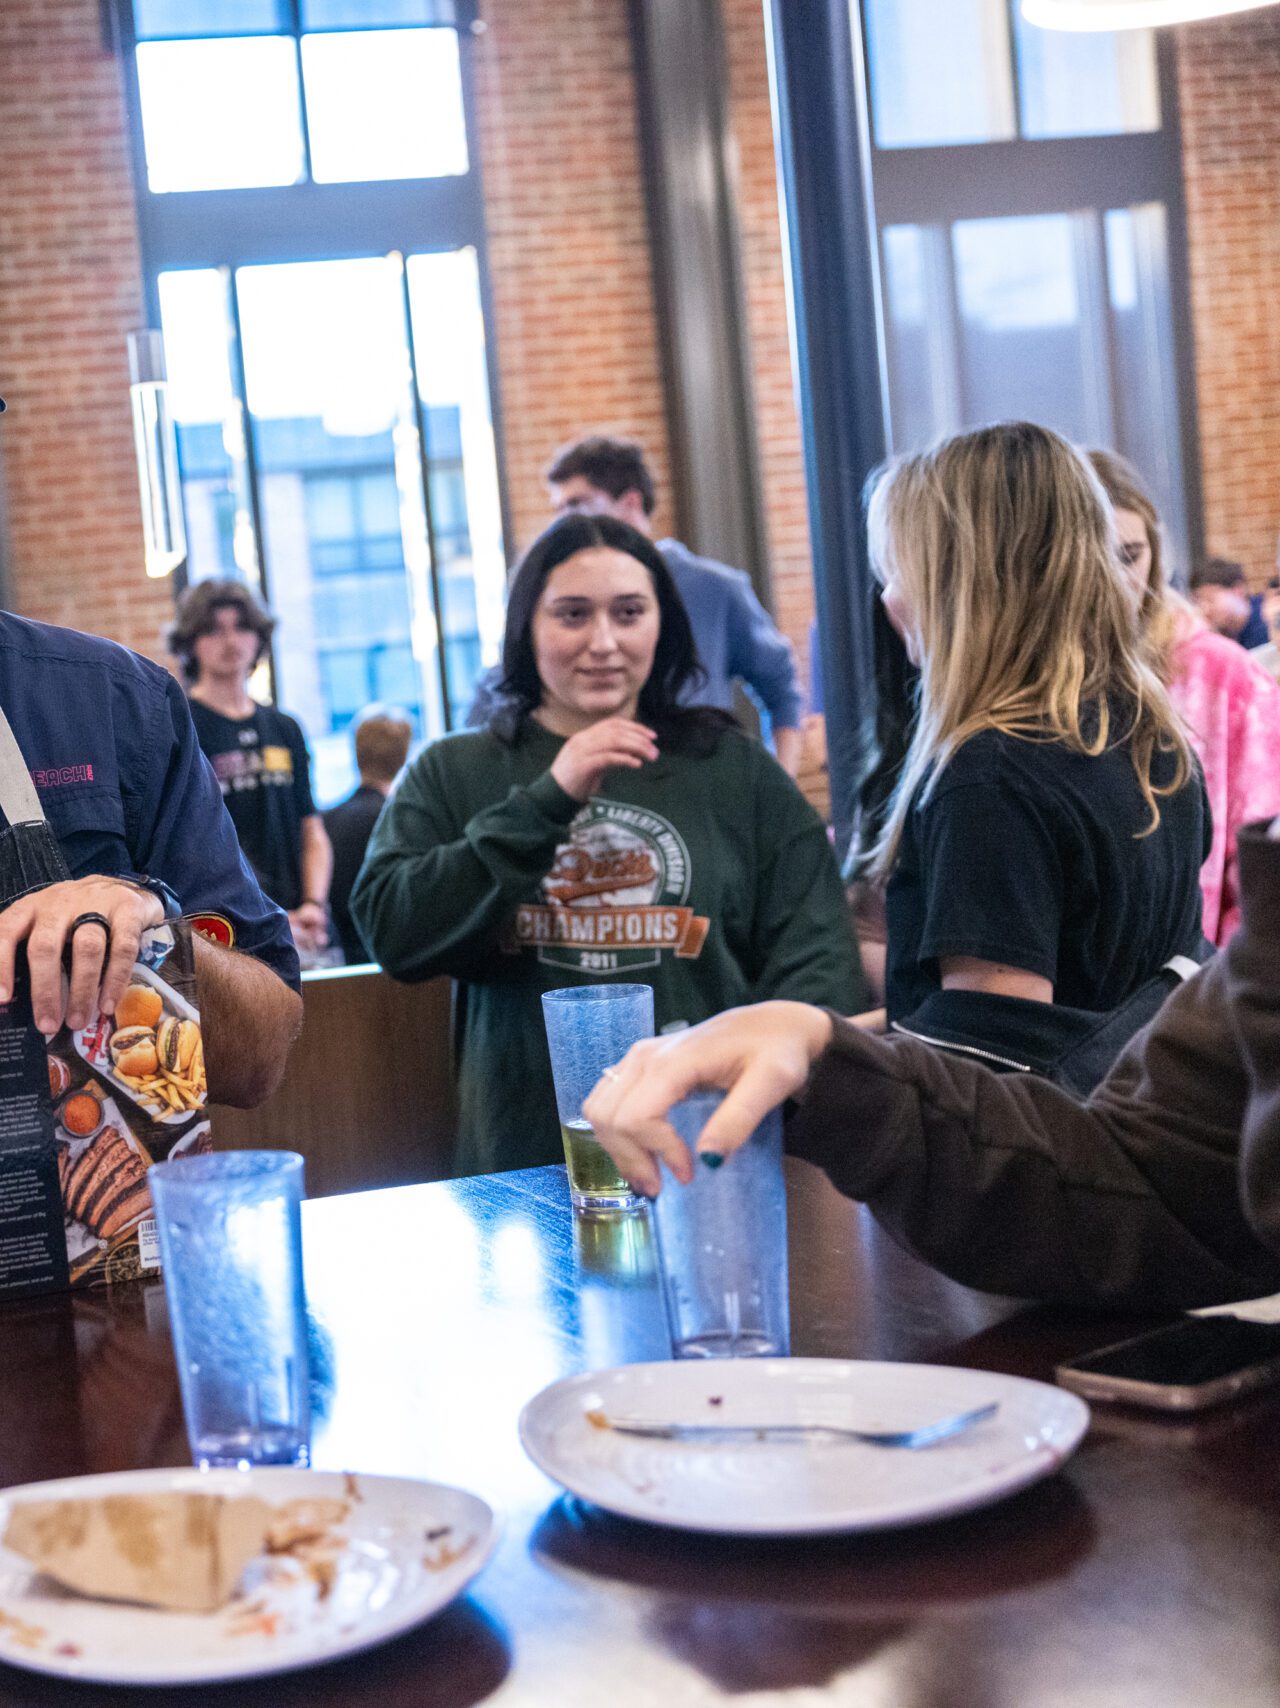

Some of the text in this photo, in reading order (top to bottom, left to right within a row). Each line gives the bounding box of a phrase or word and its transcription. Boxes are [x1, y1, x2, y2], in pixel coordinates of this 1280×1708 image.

[33, 764, 87, 787] EACH
[656, 832, 685, 895] DIVISION
[516, 911, 678, 942] CHAMPIONS
[580, 952, 618, 968] 2011
